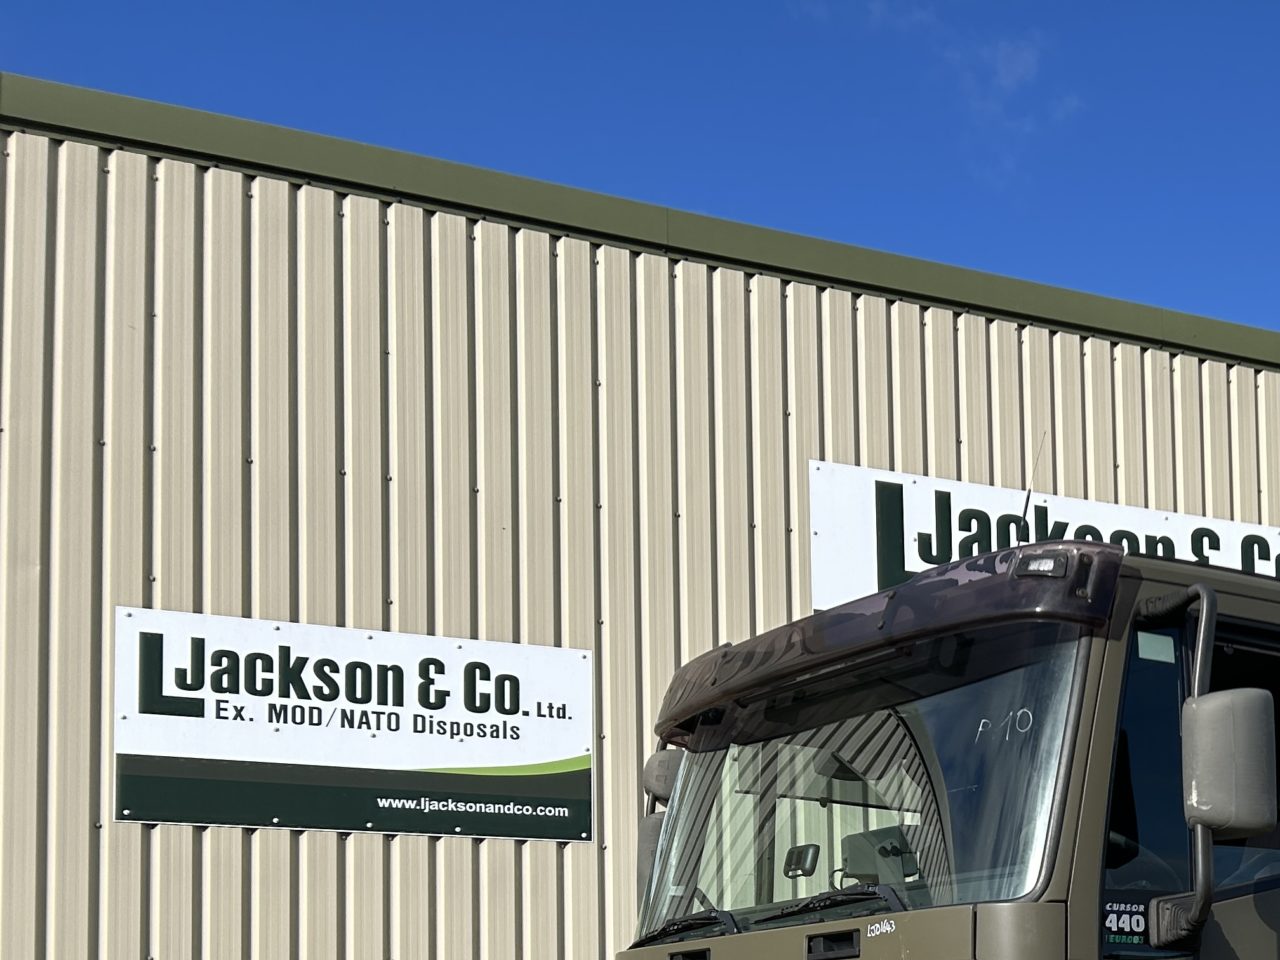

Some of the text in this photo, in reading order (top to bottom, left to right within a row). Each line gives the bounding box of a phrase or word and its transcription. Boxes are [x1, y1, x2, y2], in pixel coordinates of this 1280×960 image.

[417, 657, 451, 710] &
[463, 661, 530, 717] Co.
[535, 700, 574, 721] Ltd.
[215, 700, 522, 741] Ex. MOD/NATO Disposals
[376, 795, 569, 818] www.ljacksonandco.com
[1104, 902, 1145, 912] CURSOR
[1104, 913, 1146, 933] 440
